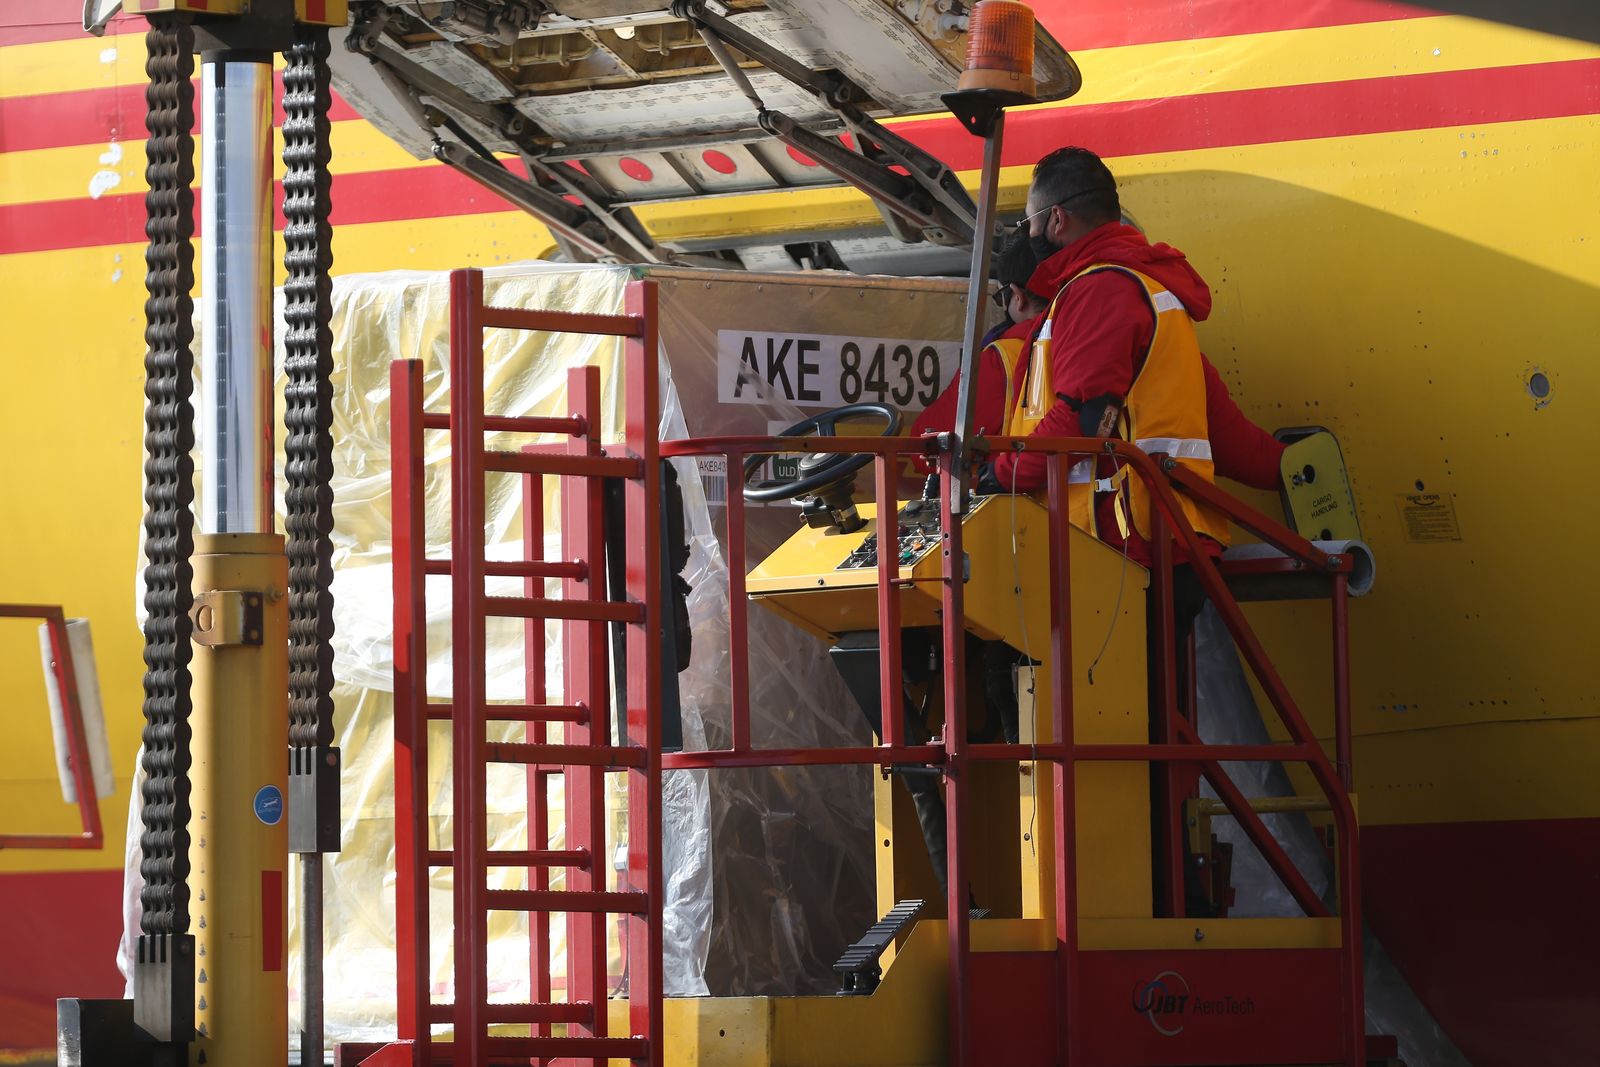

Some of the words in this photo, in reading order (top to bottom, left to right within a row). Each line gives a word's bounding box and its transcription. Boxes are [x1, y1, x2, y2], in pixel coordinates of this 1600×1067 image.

[733, 336, 821, 402] AKE
[840, 341, 941, 407] 8439
[778, 466, 796, 477] ULD
[1310, 500, 1338, 518] HANDLING
[1312, 492, 1332, 508] CARGO
[1153, 995, 1189, 1014] JBT
[1193, 995, 1255, 1016] AeroTech
